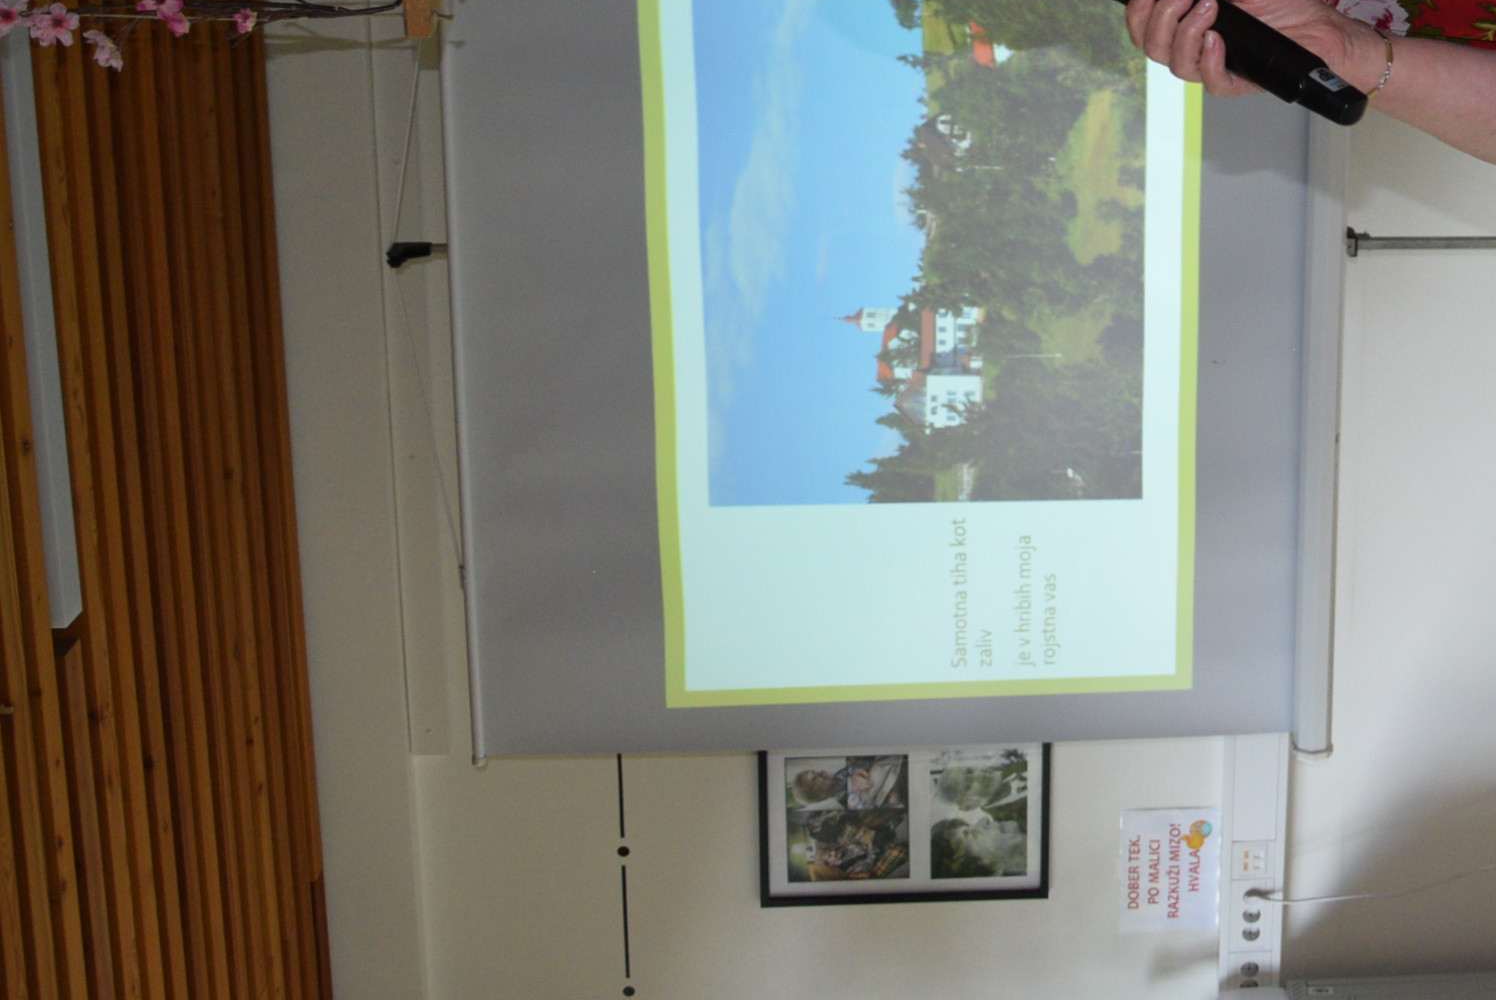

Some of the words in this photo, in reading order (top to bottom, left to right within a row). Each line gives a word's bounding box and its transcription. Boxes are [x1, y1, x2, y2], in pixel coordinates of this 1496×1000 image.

[949, 518, 967, 547] kot
[950, 552, 967, 585] tiha
[1016, 535, 1037, 578] moja
[1044, 574, 1056, 602] vas
[1014, 584, 1031, 632] hribih
[950, 591, 967, 668] Samotna
[976, 628, 993, 667] zaliv
[1019, 638, 1031, 647] v
[1039, 606, 1061, 665] rojstna
[1015, 651, 1036, 667] je
[1128, 835, 1141, 862] TEK.
[1148, 839, 1160, 884] MALICI
[1169, 823, 1181, 862] MIZO!
[1127, 866, 1140, 910] DOBER
[1147, 887, 1159, 904] PO
[1166, 865, 1180, 918] RAZKUŽI
